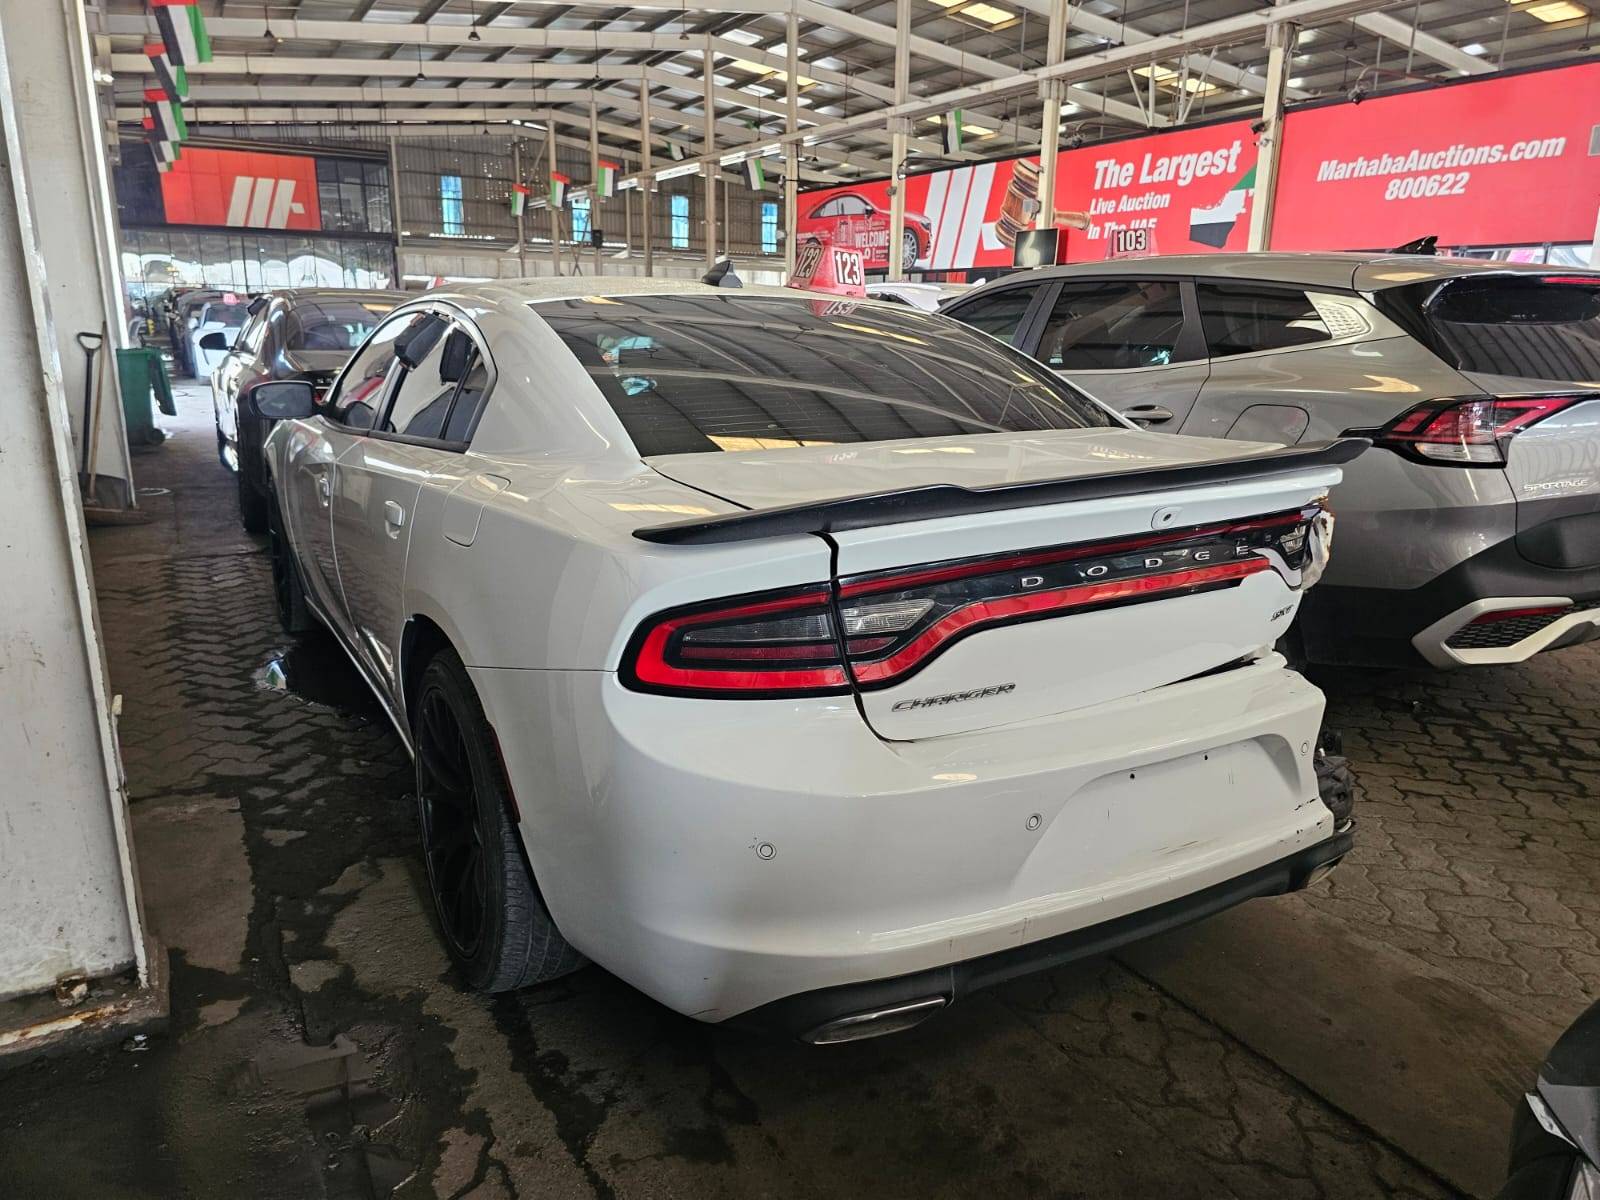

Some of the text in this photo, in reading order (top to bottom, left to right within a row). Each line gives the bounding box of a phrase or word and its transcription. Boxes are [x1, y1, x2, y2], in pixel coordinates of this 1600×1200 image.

[1093, 139, 1242, 191] The Largest
[1316, 136, 1567, 182] MarhabaAuctions.com
[1384, 172, 1470, 200] 800622
[1089, 192, 1171, 216] Live Auction
[854, 230, 890, 248] WELCOME
[1087, 223, 1101, 240] In
[1118, 229, 1147, 252] 103
[796, 248, 820, 278] 123
[835, 251, 862, 286] 123
[1523, 479, 1590, 493] SPORTAGE
[1020, 545, 1250, 588] DODGE
[891, 683, 1017, 713] CHARGER
